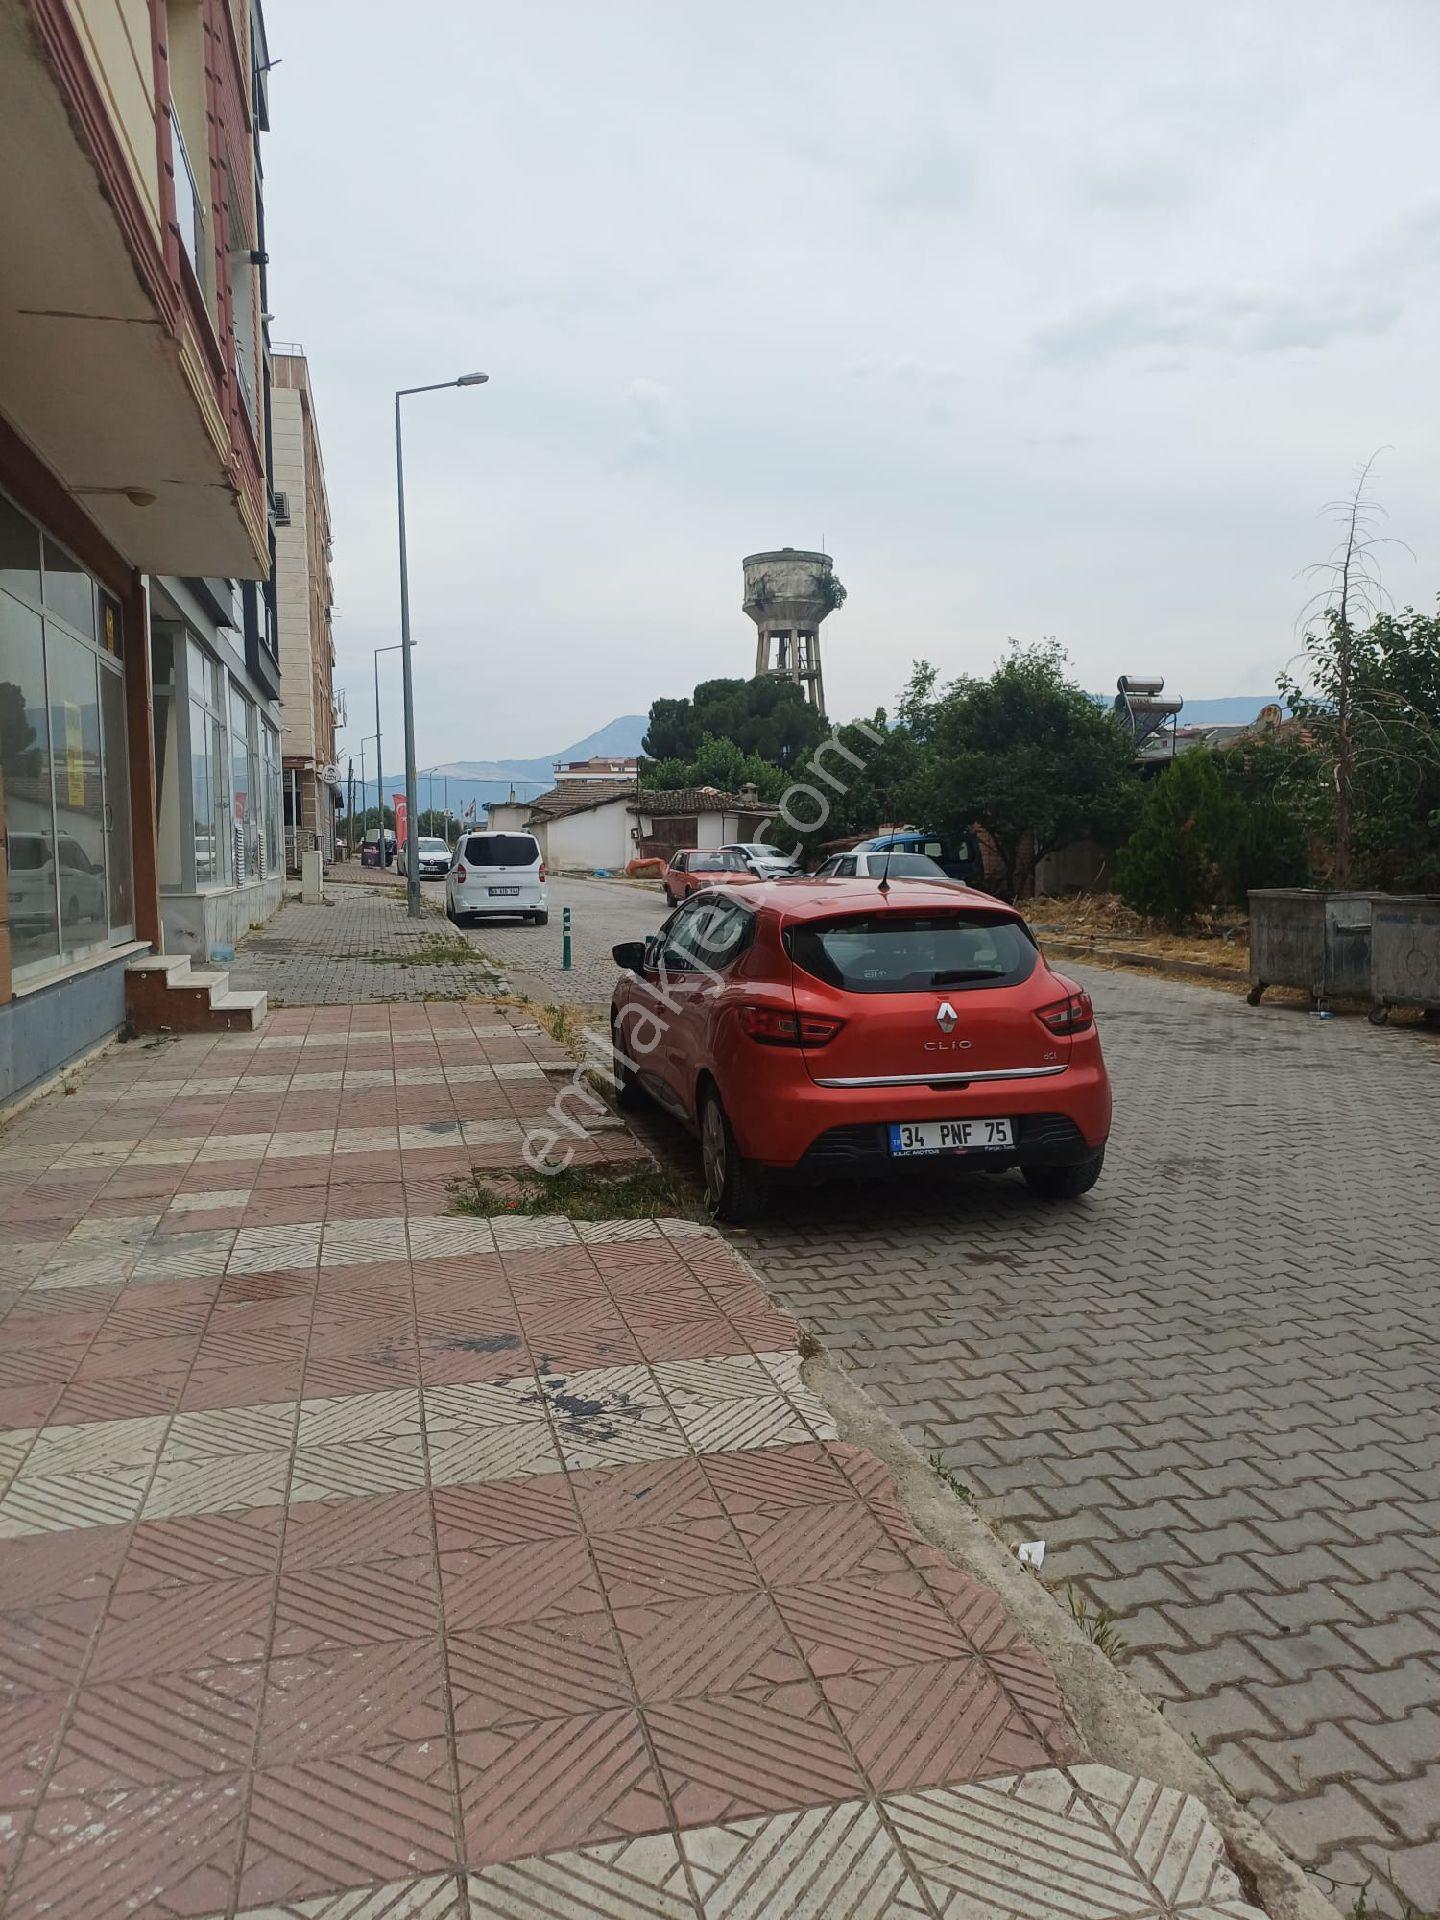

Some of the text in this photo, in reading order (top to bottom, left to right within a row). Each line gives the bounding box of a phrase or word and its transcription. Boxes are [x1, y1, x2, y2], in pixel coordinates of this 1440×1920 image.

[923, 1040, 972, 1051] CLIO
[901, 1127, 925, 1148] 34
[940, 1123, 972, 1146] PNF
[984, 1121, 1007, 1143] 75
